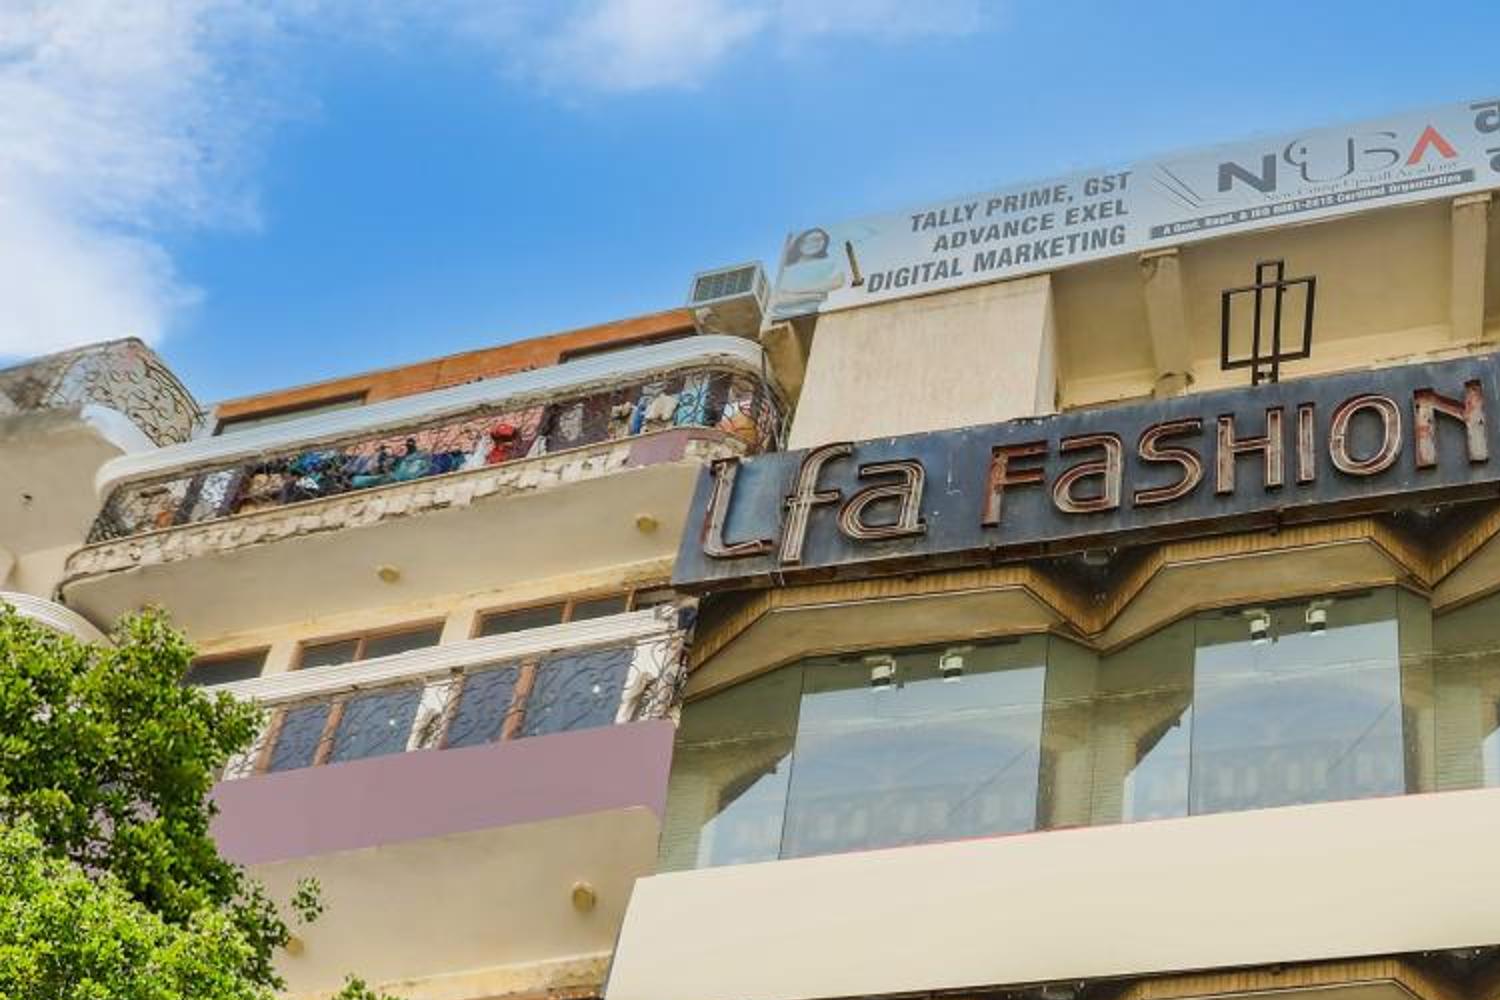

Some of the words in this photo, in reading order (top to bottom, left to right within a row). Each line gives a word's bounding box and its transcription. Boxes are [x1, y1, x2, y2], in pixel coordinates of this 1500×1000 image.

[911, 203, 979, 232] TALLY
[985, 183, 1074, 217] PRIME,
[1083, 171, 1133, 197] GST
[933, 212, 1055, 252] ADVANCE
[1065, 199, 1130, 226] EXEL
[867, 257, 963, 293] DIGITAL
[973, 224, 1127, 272] MARKETING
